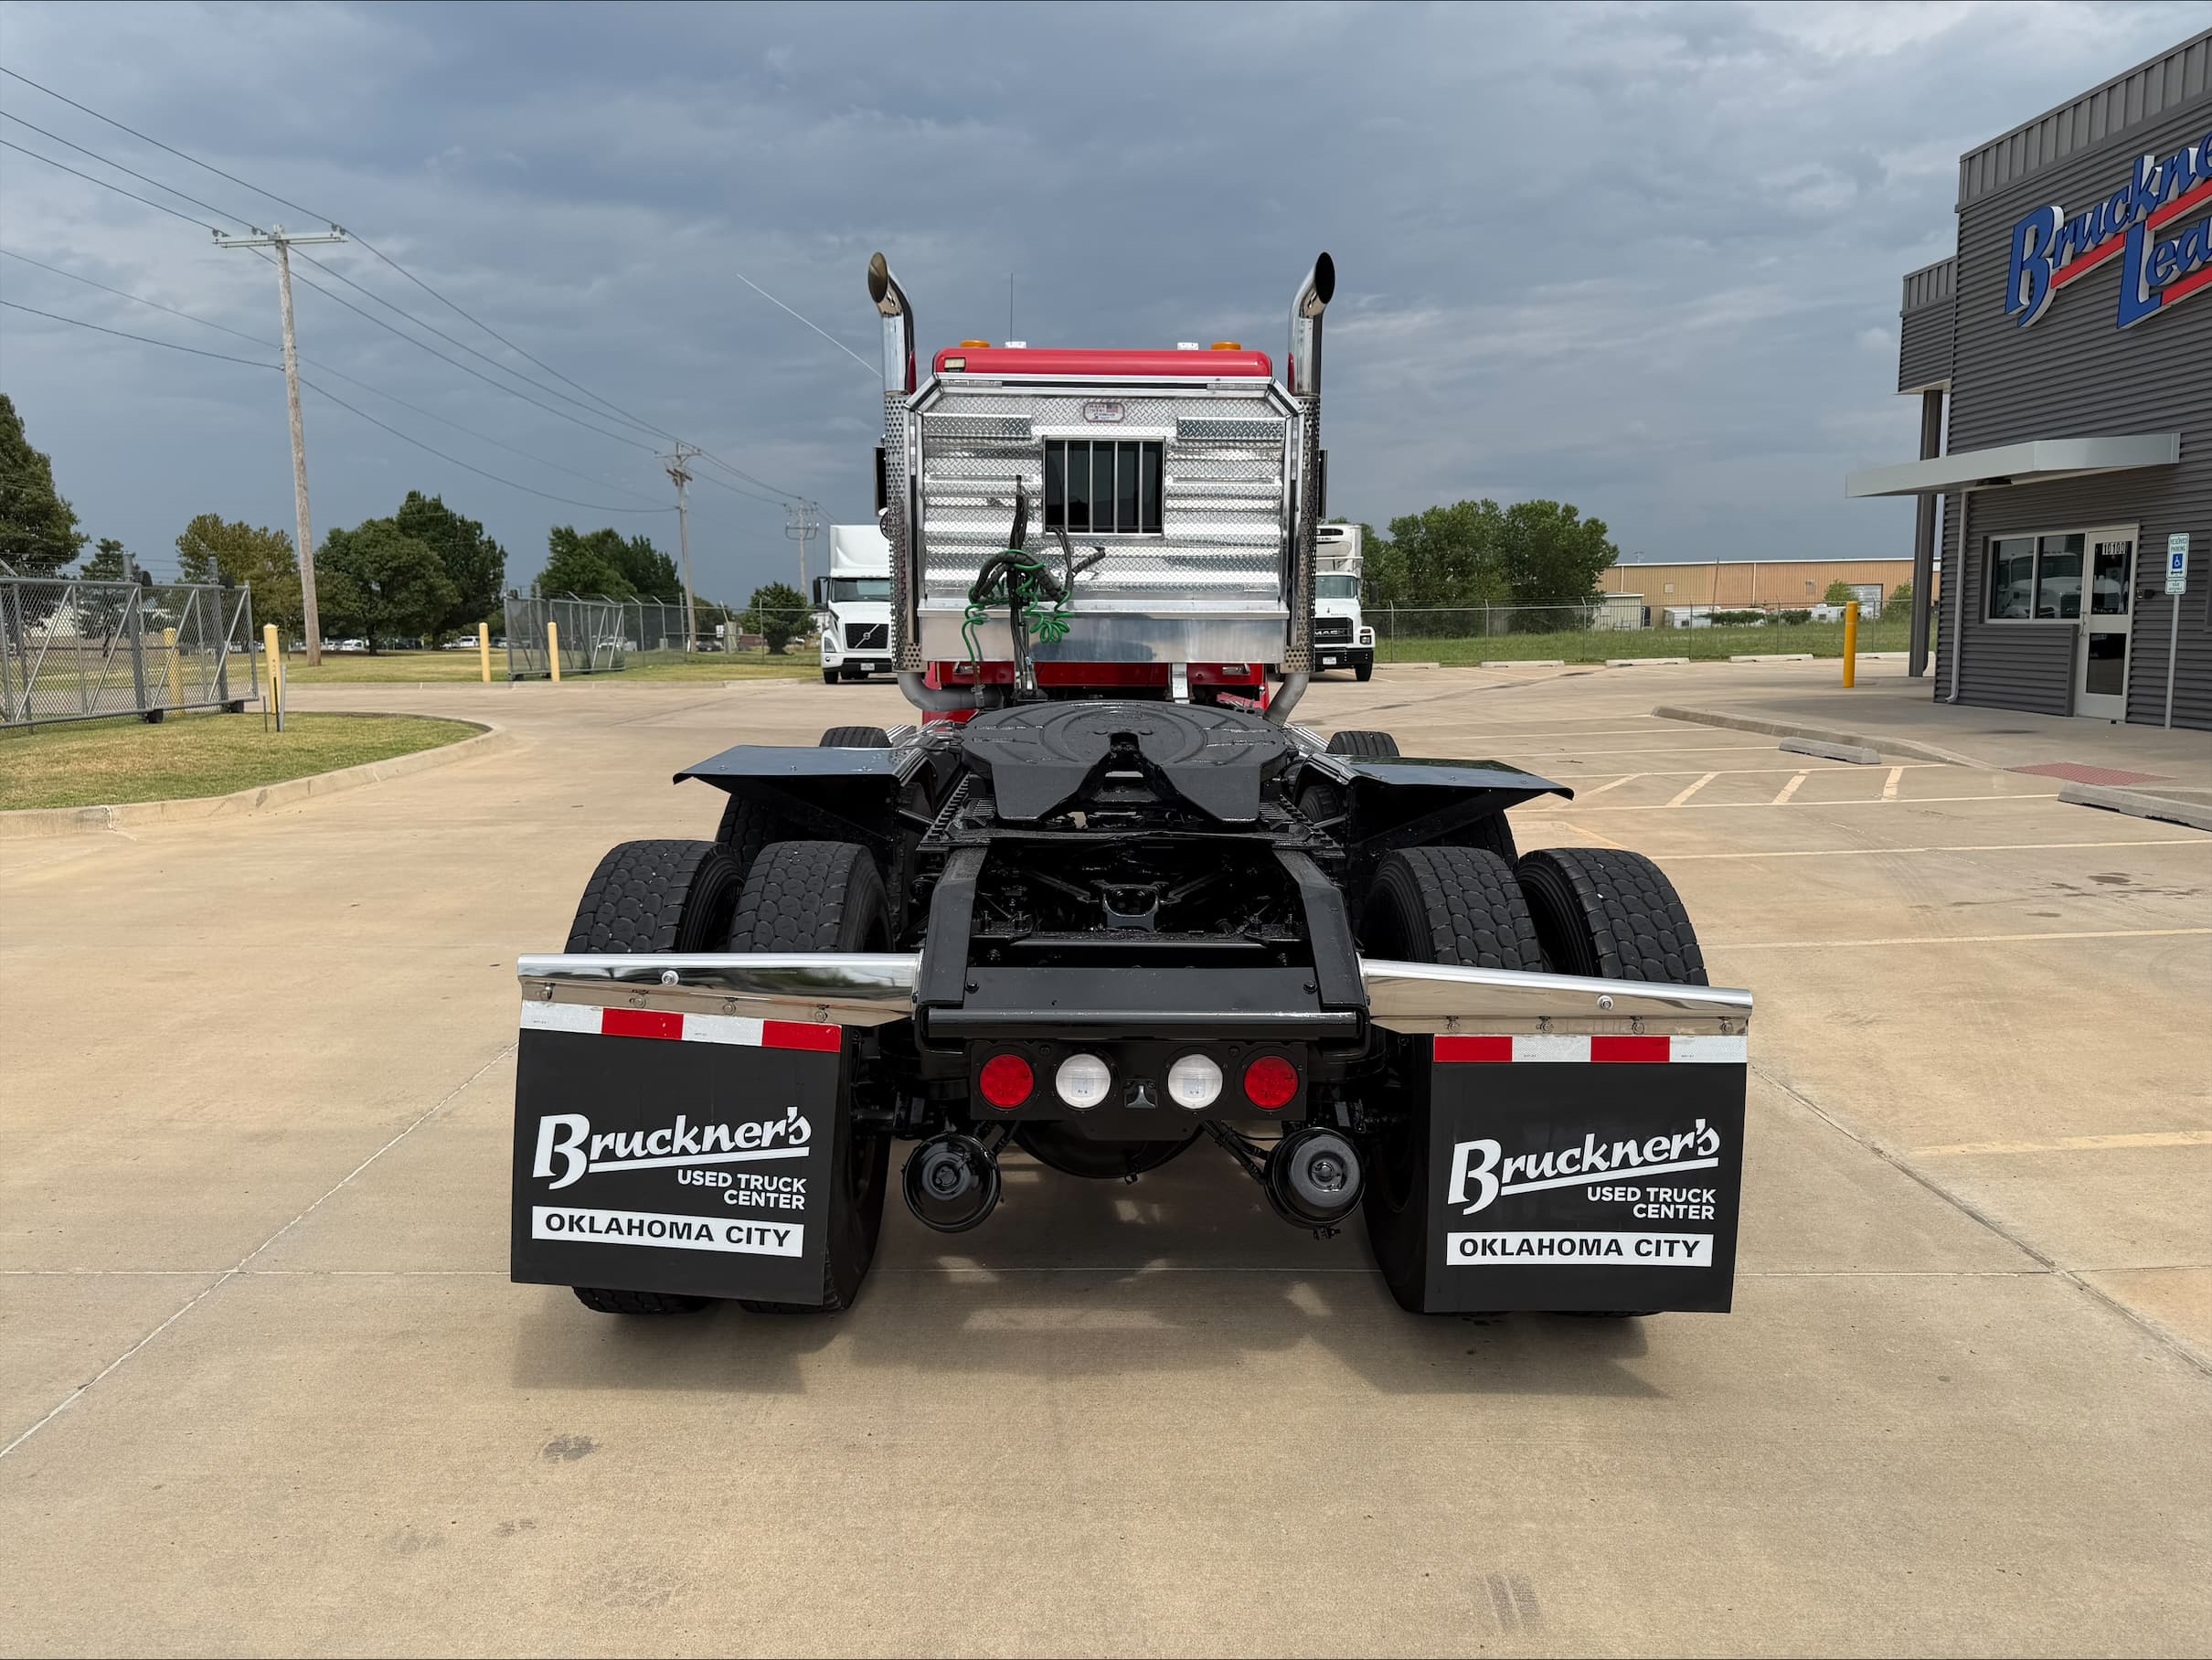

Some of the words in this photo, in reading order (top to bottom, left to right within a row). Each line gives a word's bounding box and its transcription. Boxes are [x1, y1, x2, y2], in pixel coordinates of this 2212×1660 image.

[532, 1106, 812, 1190] Bruckner's
[1447, 1118, 1720, 1216] Bruckner's
[676, 1169, 732, 1188] USED
[737, 1174, 807, 1194] TRUCK
[723, 1189, 804, 1210] CENTER
[1587, 1186, 1641, 1202] USED
[1645, 1187, 1717, 1204] TRUCK
[1632, 1204, 1715, 1220] CENTER
[546, 1213, 714, 1242] OKLAHOMA
[726, 1225, 791, 1247] CITY
[1459, 1238, 1623, 1257] OKLAHOMA
[1634, 1240, 1701, 1259] CITY
